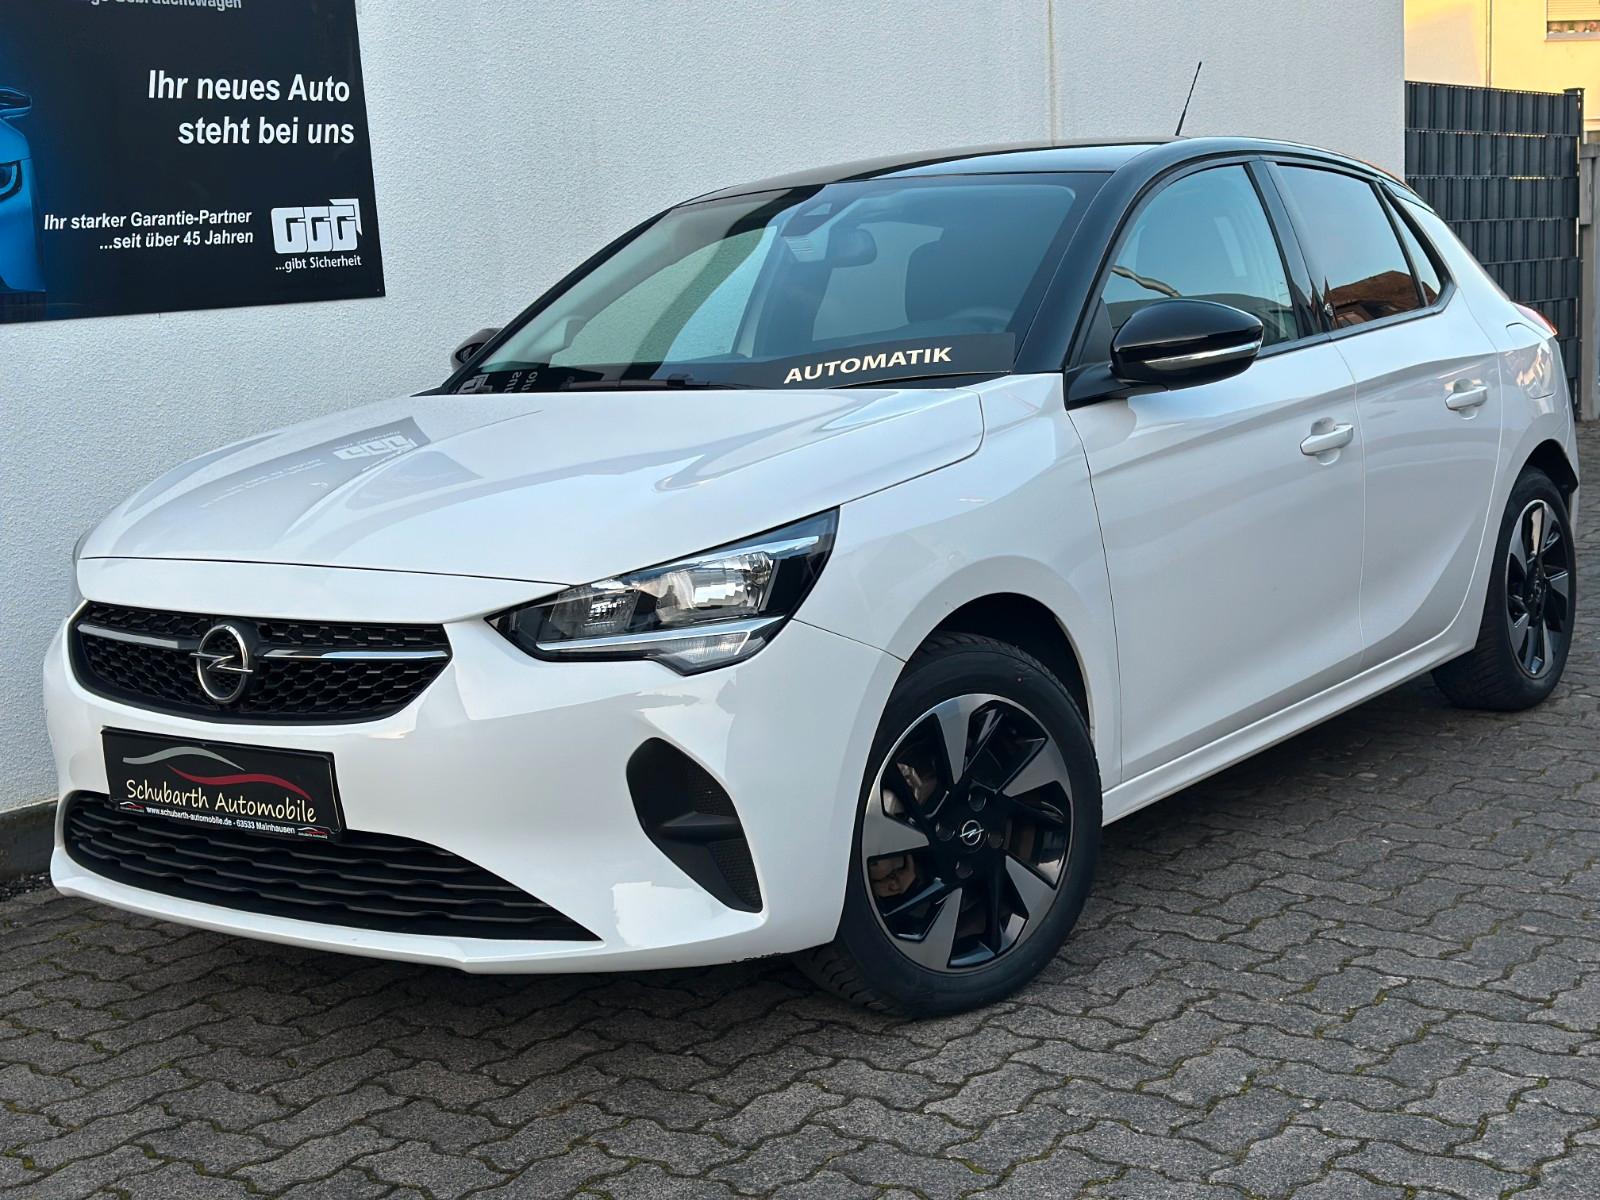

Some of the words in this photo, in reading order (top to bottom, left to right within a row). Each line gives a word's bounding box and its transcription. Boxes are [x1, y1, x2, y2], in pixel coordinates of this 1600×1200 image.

[149, 70, 188, 98] Ihr
[198, 79, 280, 100] neues
[288, 74, 349, 101] Auto
[178, 116, 250, 144] steht
[259, 117, 298, 144] bei
[308, 124, 354, 143] uns
[45, 215, 67, 229] Ihr
[71, 213, 126, 229] starker
[131, 209, 252, 228] Garantie-Partner
[99, 230, 142, 250] ...seit
[146, 233, 179, 247] über
[184, 231, 200, 245] 45
[205, 230, 253, 244] Jahren
[276, 258, 306, 272] ...gibt
[310, 255, 361, 268] Sicherheit
[784, 346, 953, 384] AUTOMATIK
[126, 779, 209, 809] Schubarth
[214, 791, 317, 823] Automobile
[145, 806, 232, 826] www.schubarth-automobile.de
[255, 821, 296, 835] Mainhausen
